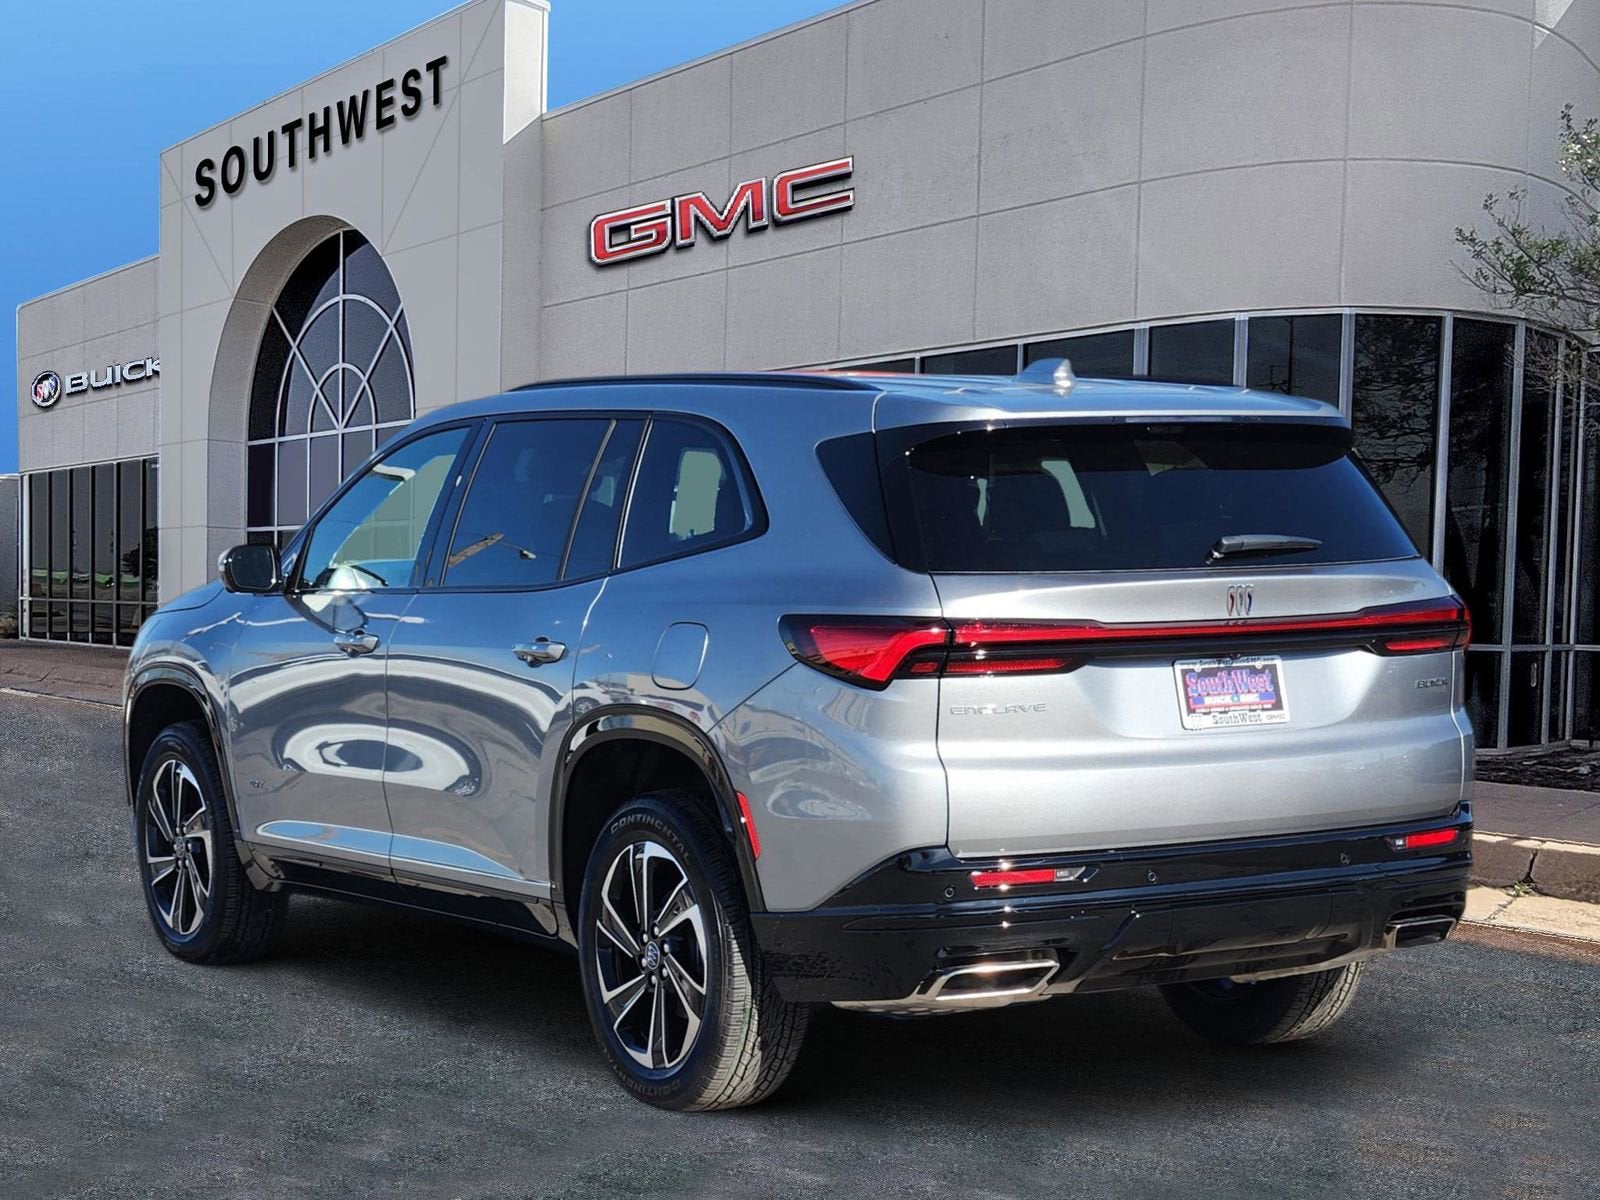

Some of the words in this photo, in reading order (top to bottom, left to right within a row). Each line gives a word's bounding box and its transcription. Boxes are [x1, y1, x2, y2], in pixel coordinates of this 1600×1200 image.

[194, 55, 447, 207] SOUTHWEST
[589, 156, 855, 264] GMC
[64, 357, 160, 395] BUICK
[1186, 669, 1273, 696] SouthWest
[950, 703, 1047, 715] ENCLAVE
[1212, 712, 1262, 725] SouthWest
